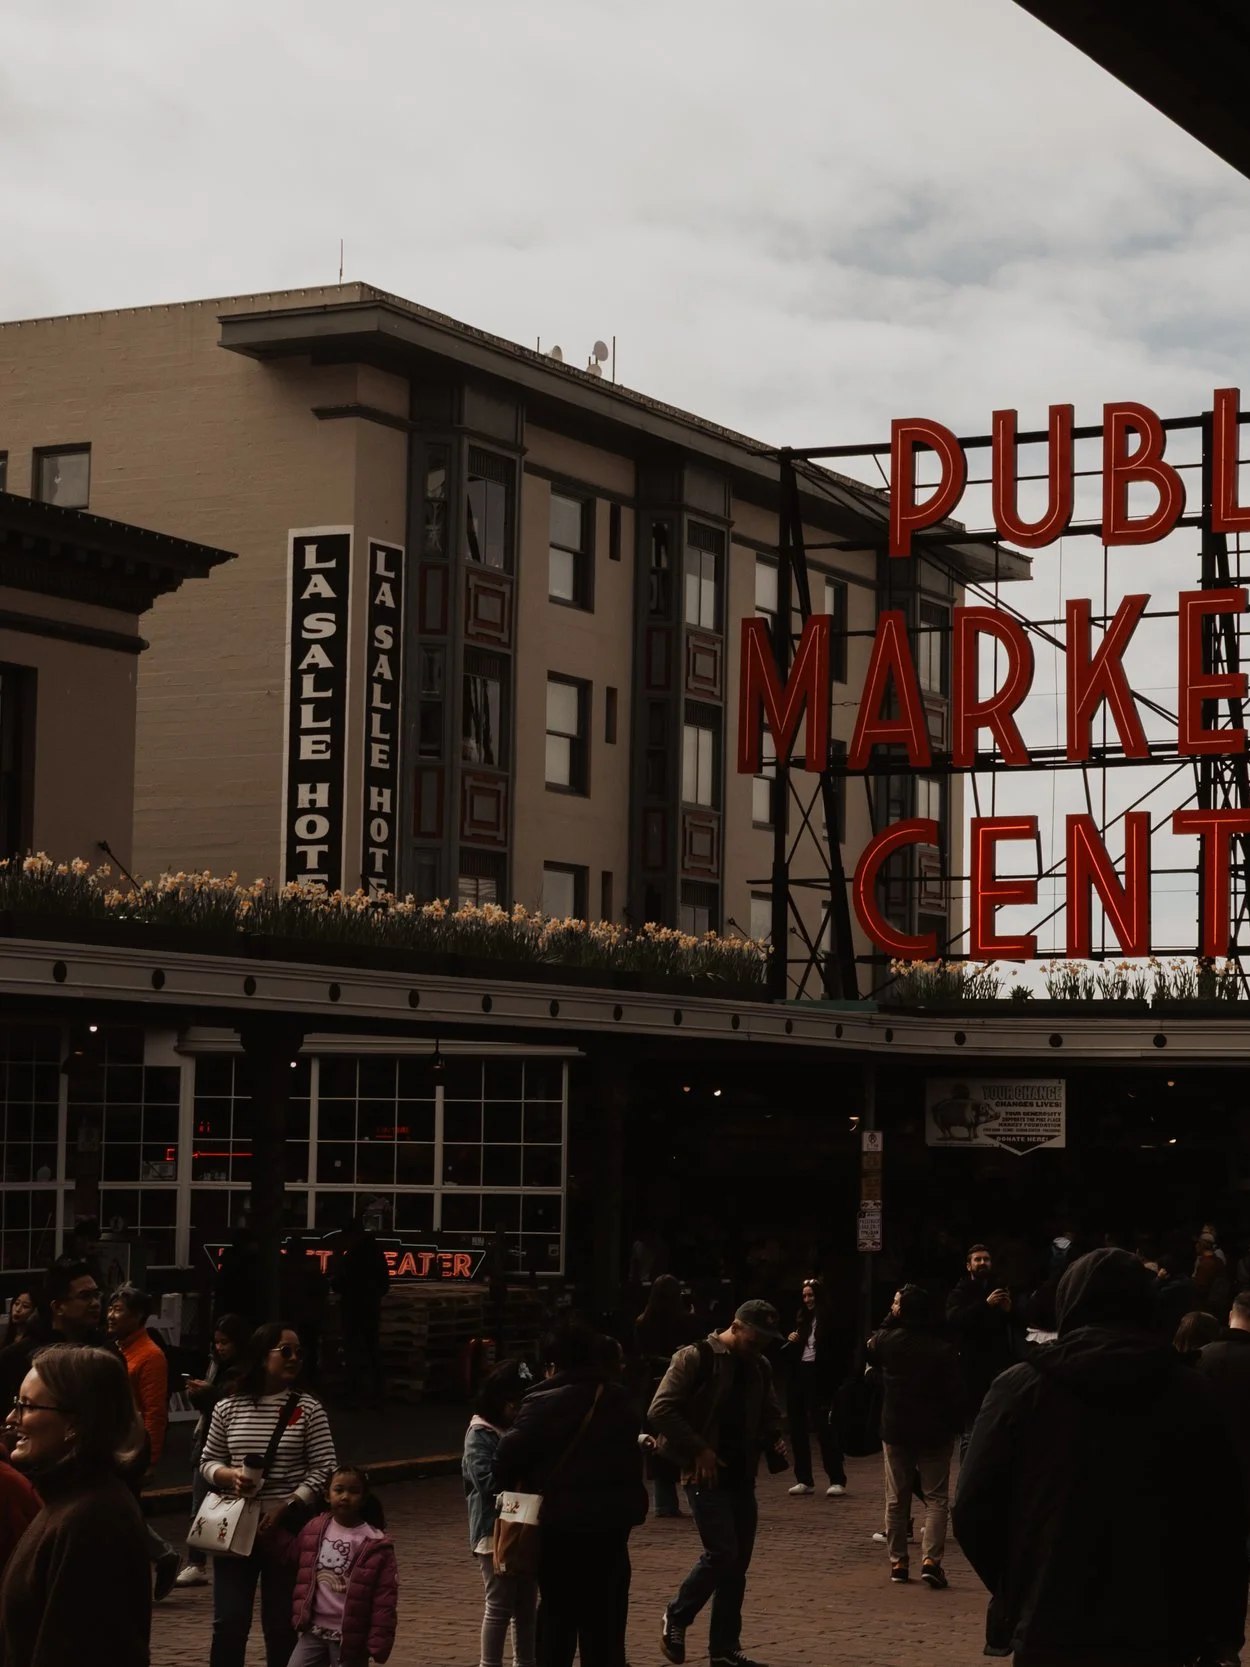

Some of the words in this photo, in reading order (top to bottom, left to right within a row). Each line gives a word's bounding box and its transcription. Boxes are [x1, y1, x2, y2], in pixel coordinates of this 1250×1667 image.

[300, 543, 337, 600] LA
[374, 550, 396, 609] LA
[297, 612, 337, 761] SALLE
[370, 625, 394, 770] SALLE
[982, 1085, 1014, 1100] YOUR
[1015, 1085, 1062, 1100] CHANGE
